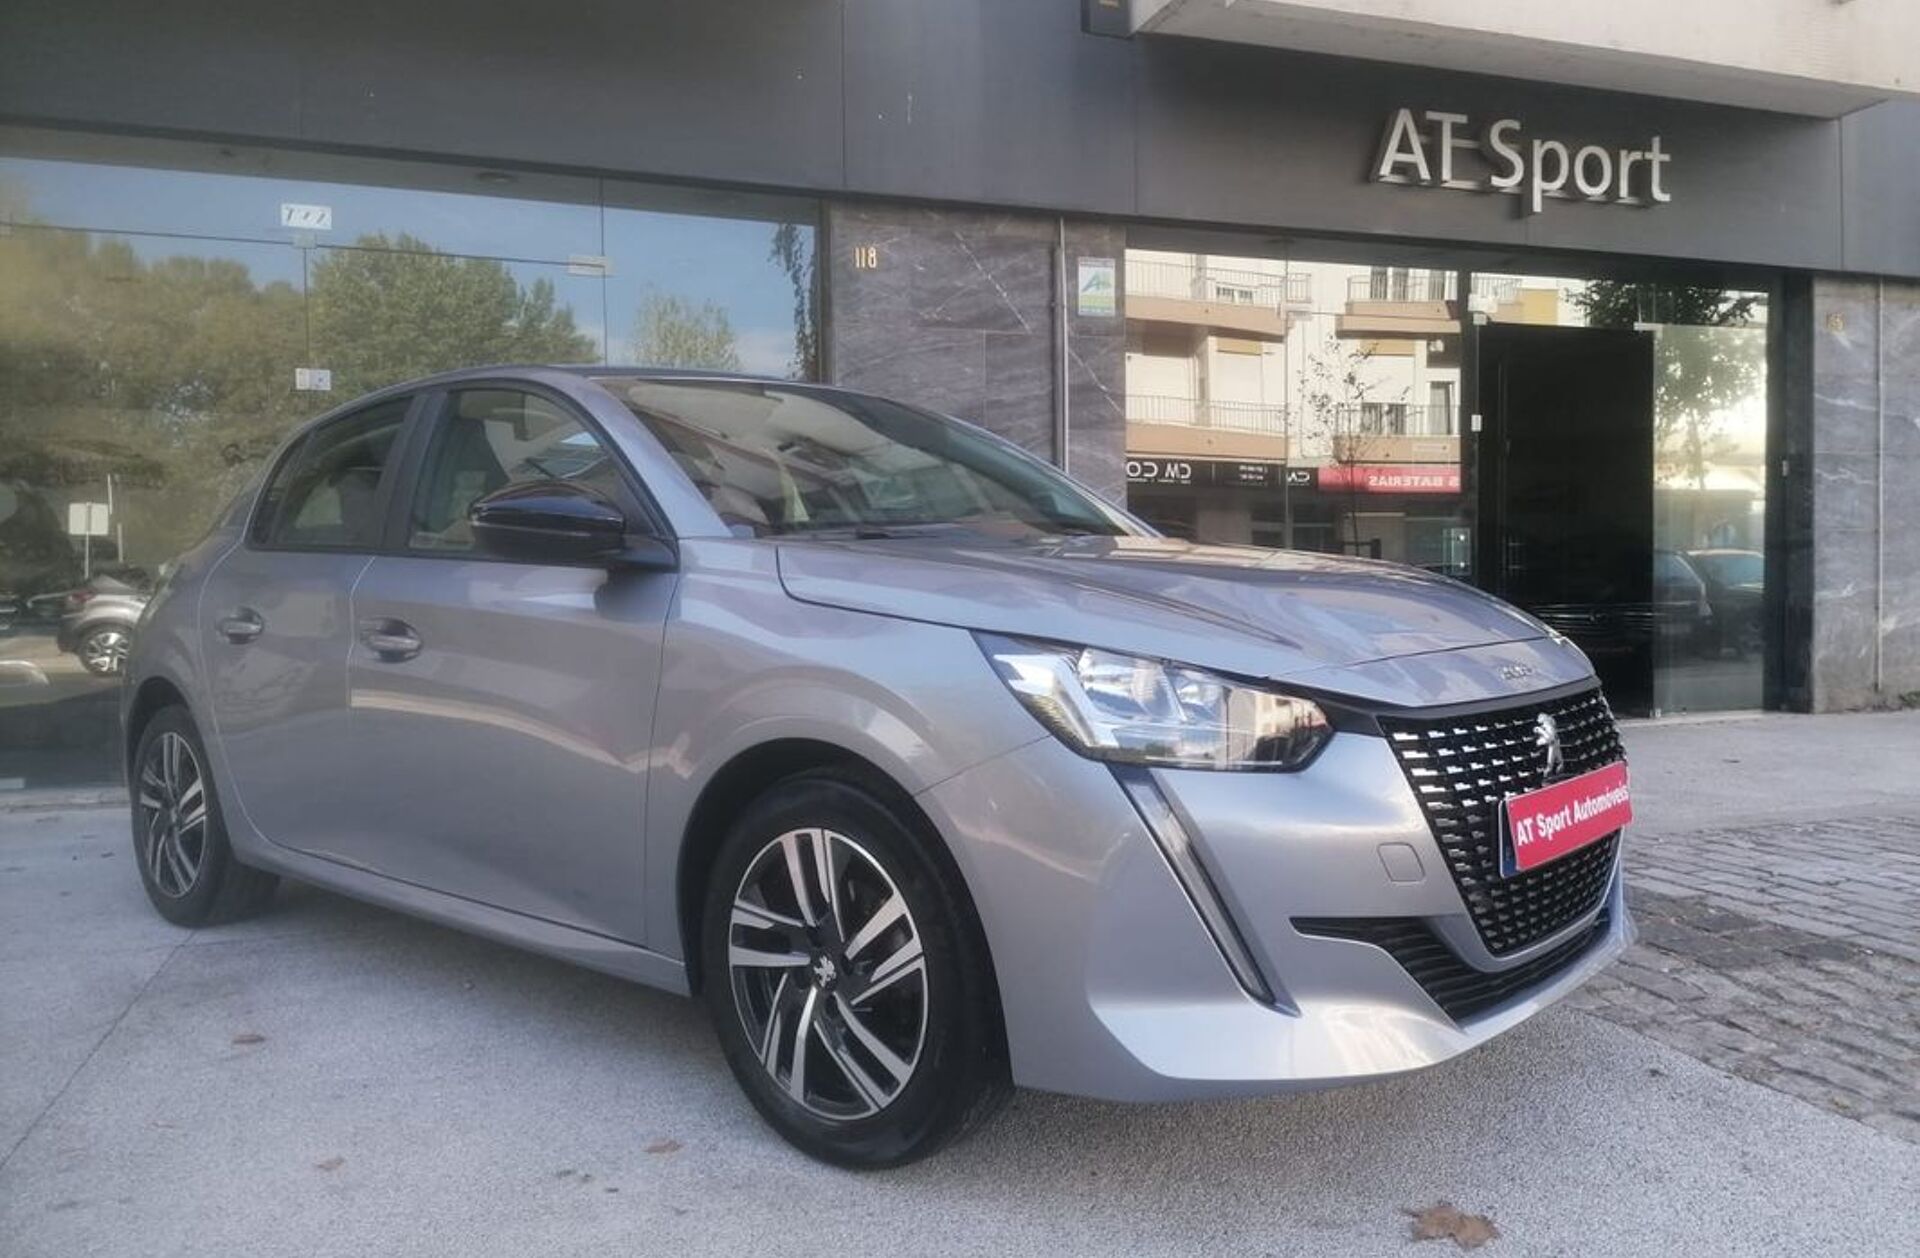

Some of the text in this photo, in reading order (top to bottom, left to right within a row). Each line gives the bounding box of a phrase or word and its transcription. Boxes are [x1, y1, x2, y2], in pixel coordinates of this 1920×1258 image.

[1378, 107, 1672, 213] AT Sport
[854, 246, 877, 269] 118
[1516, 816, 1534, 847] AT
[1536, 804, 1573, 841] Sport
